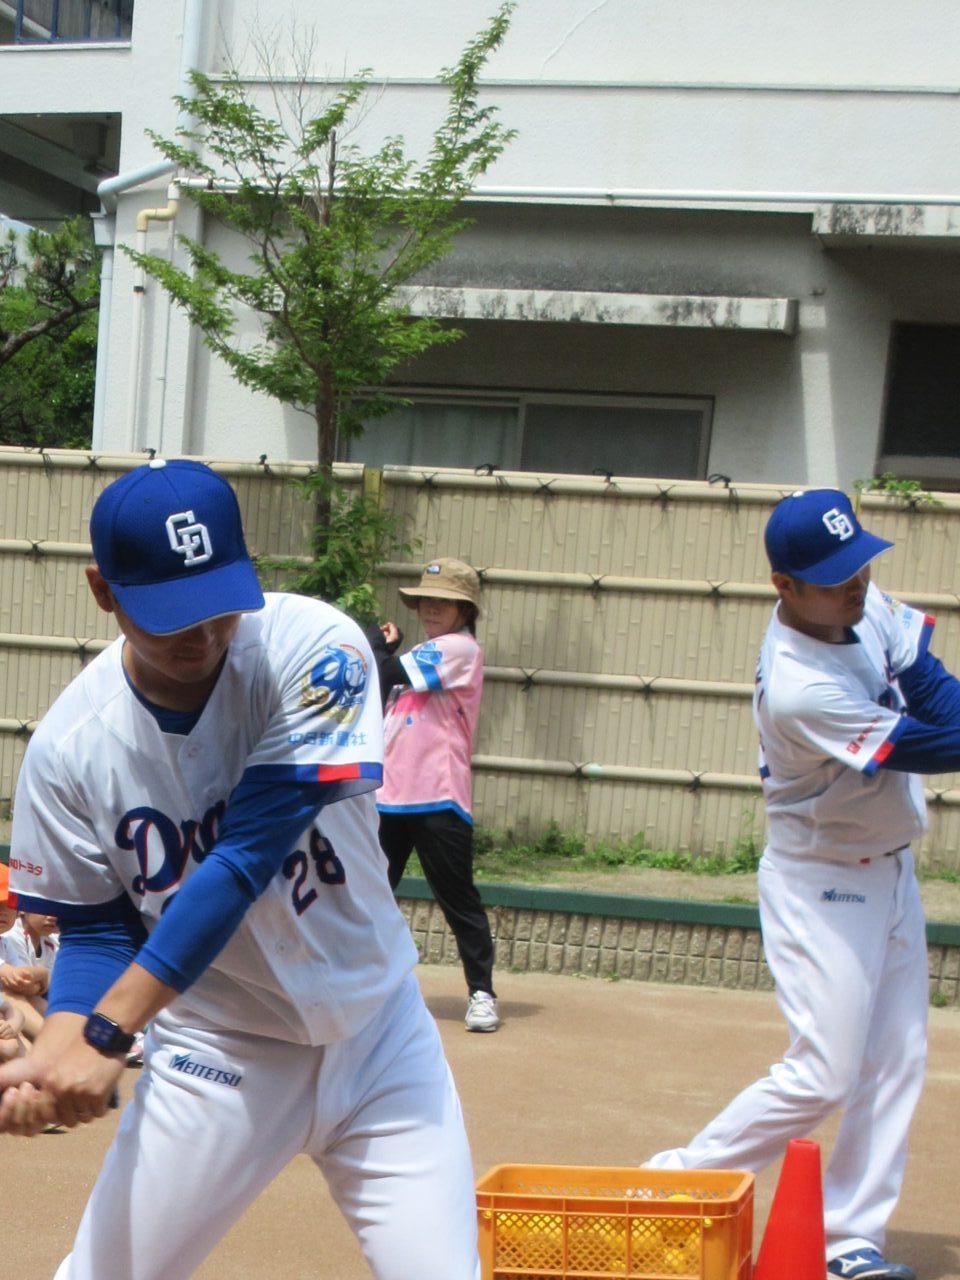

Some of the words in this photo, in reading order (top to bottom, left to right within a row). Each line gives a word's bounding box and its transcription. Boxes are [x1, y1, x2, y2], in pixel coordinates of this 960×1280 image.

[165, 509, 213, 567] CD
[282, 826, 346, 917] 28
[169, 1053, 242, 1087] MEITETSU
